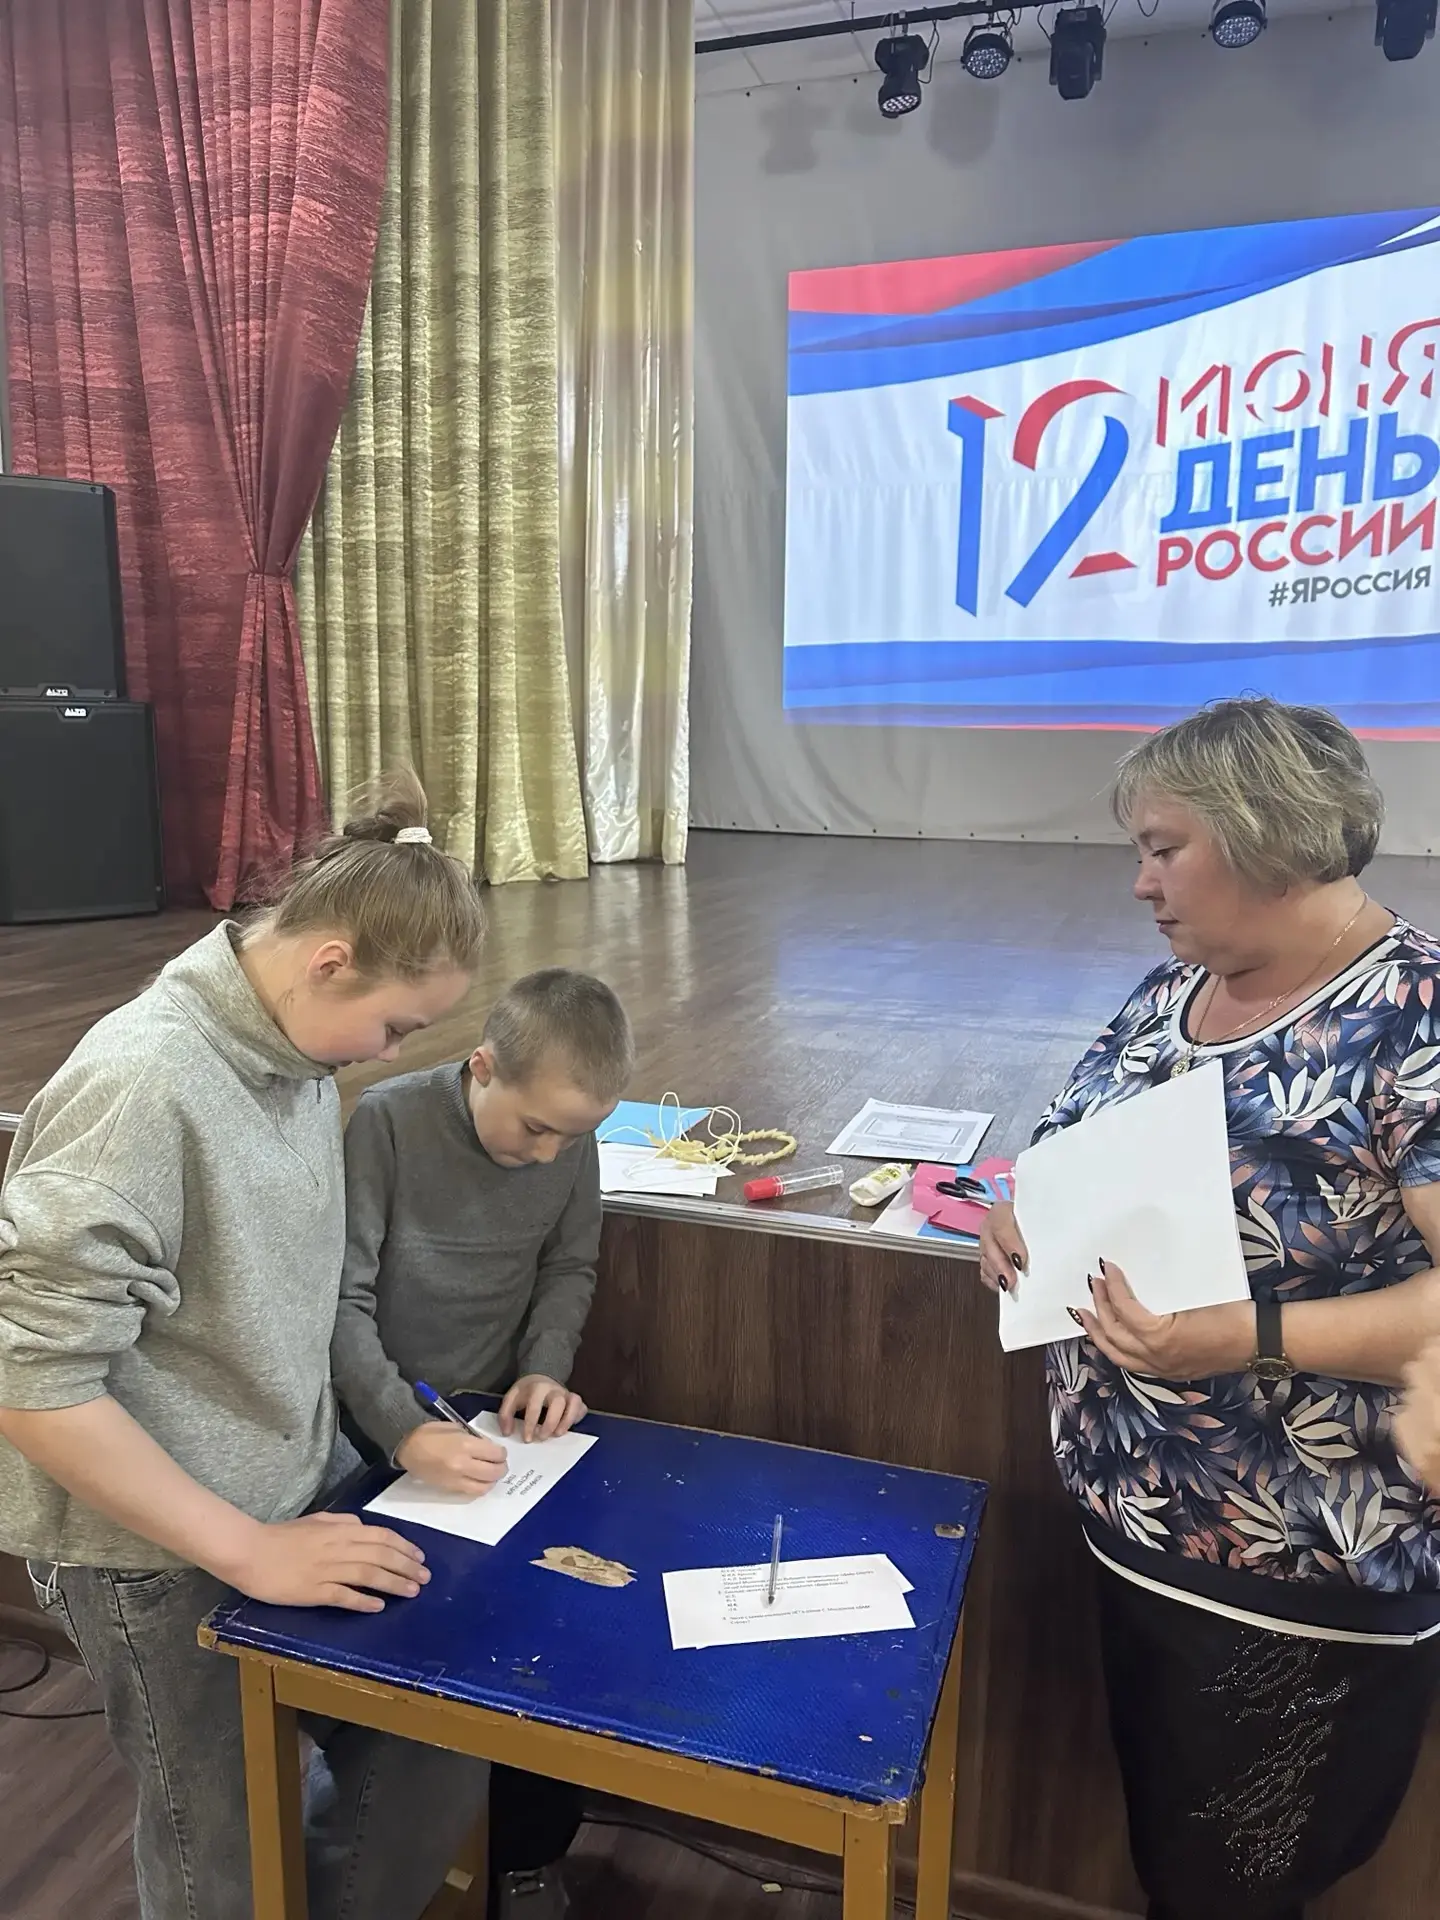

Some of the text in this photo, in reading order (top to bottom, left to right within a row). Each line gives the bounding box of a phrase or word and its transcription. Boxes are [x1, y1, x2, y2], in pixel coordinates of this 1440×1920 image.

[947, 318, 1440, 616] 12 ИЮНЯ
[1160, 412, 1440, 533] ДЕНЬ
[1157, 497, 1438, 587] РОССИИ
